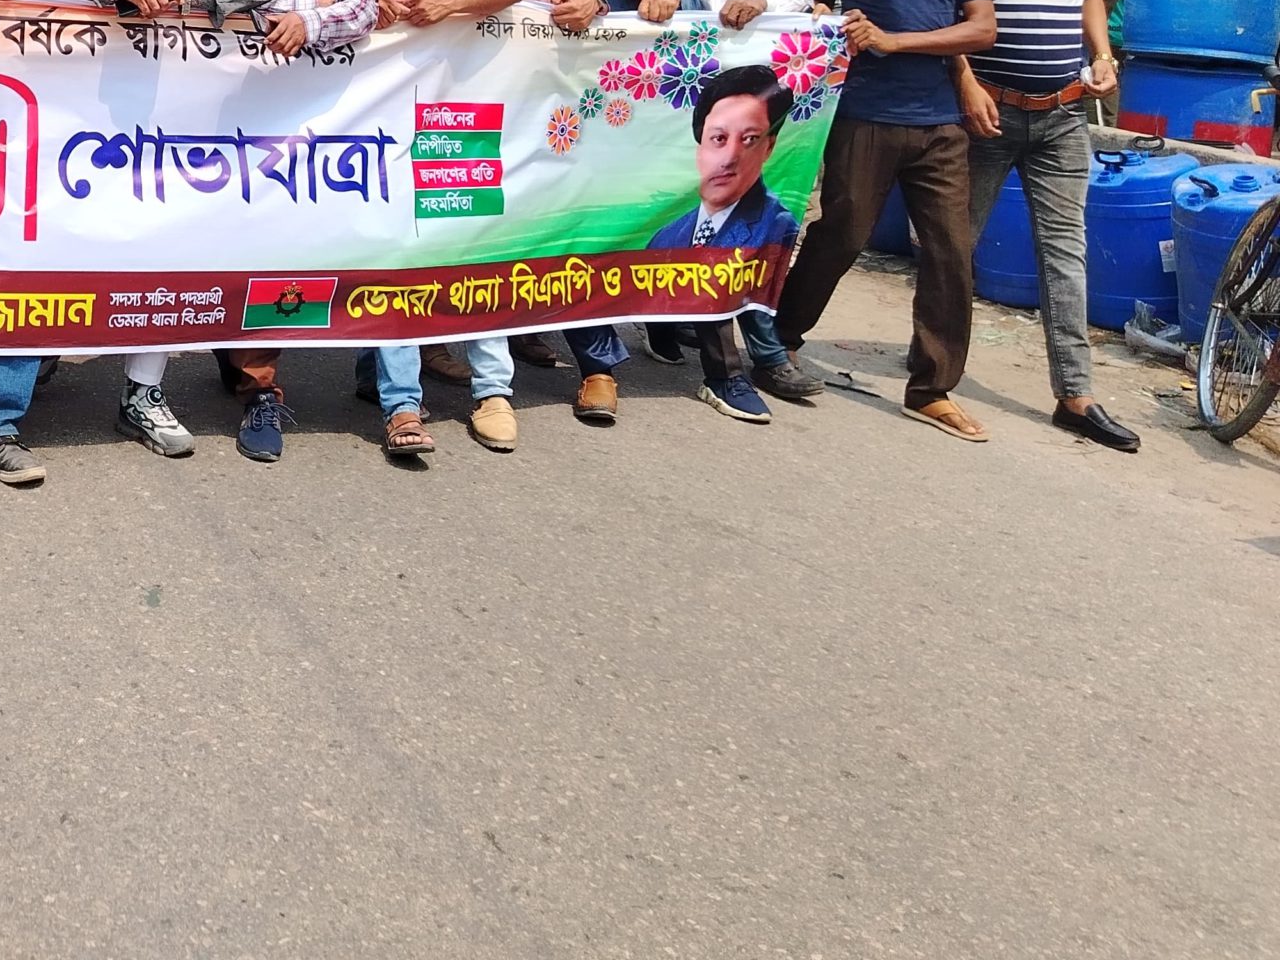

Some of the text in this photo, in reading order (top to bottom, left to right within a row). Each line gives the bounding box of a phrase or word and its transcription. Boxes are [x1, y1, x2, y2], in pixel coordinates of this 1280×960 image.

[475, 15, 516, 39] শহীদ
[521, 17, 554, 40] জিয়া
[120, 18, 225, 62] স্বাগত
[416, 134, 463, 158] নিপীড়িত
[57, 123, 399, 204] শোভাযাত্রা
[419, 162, 496, 185] জনগণের প্রতি
[419, 191, 474, 213] সহমর্মিতা
[109, 292, 142, 307] সদস্য
[145, 287, 177, 306] সচিব
[345, 277, 441, 320] ডেমরা
[448, 275, 502, 316] থানা
[510, 257, 596, 311] বিএনপি
[601, 269, 622, 298] ও
[108, 307, 227, 328] ডেমরা থানা বিএনপি
